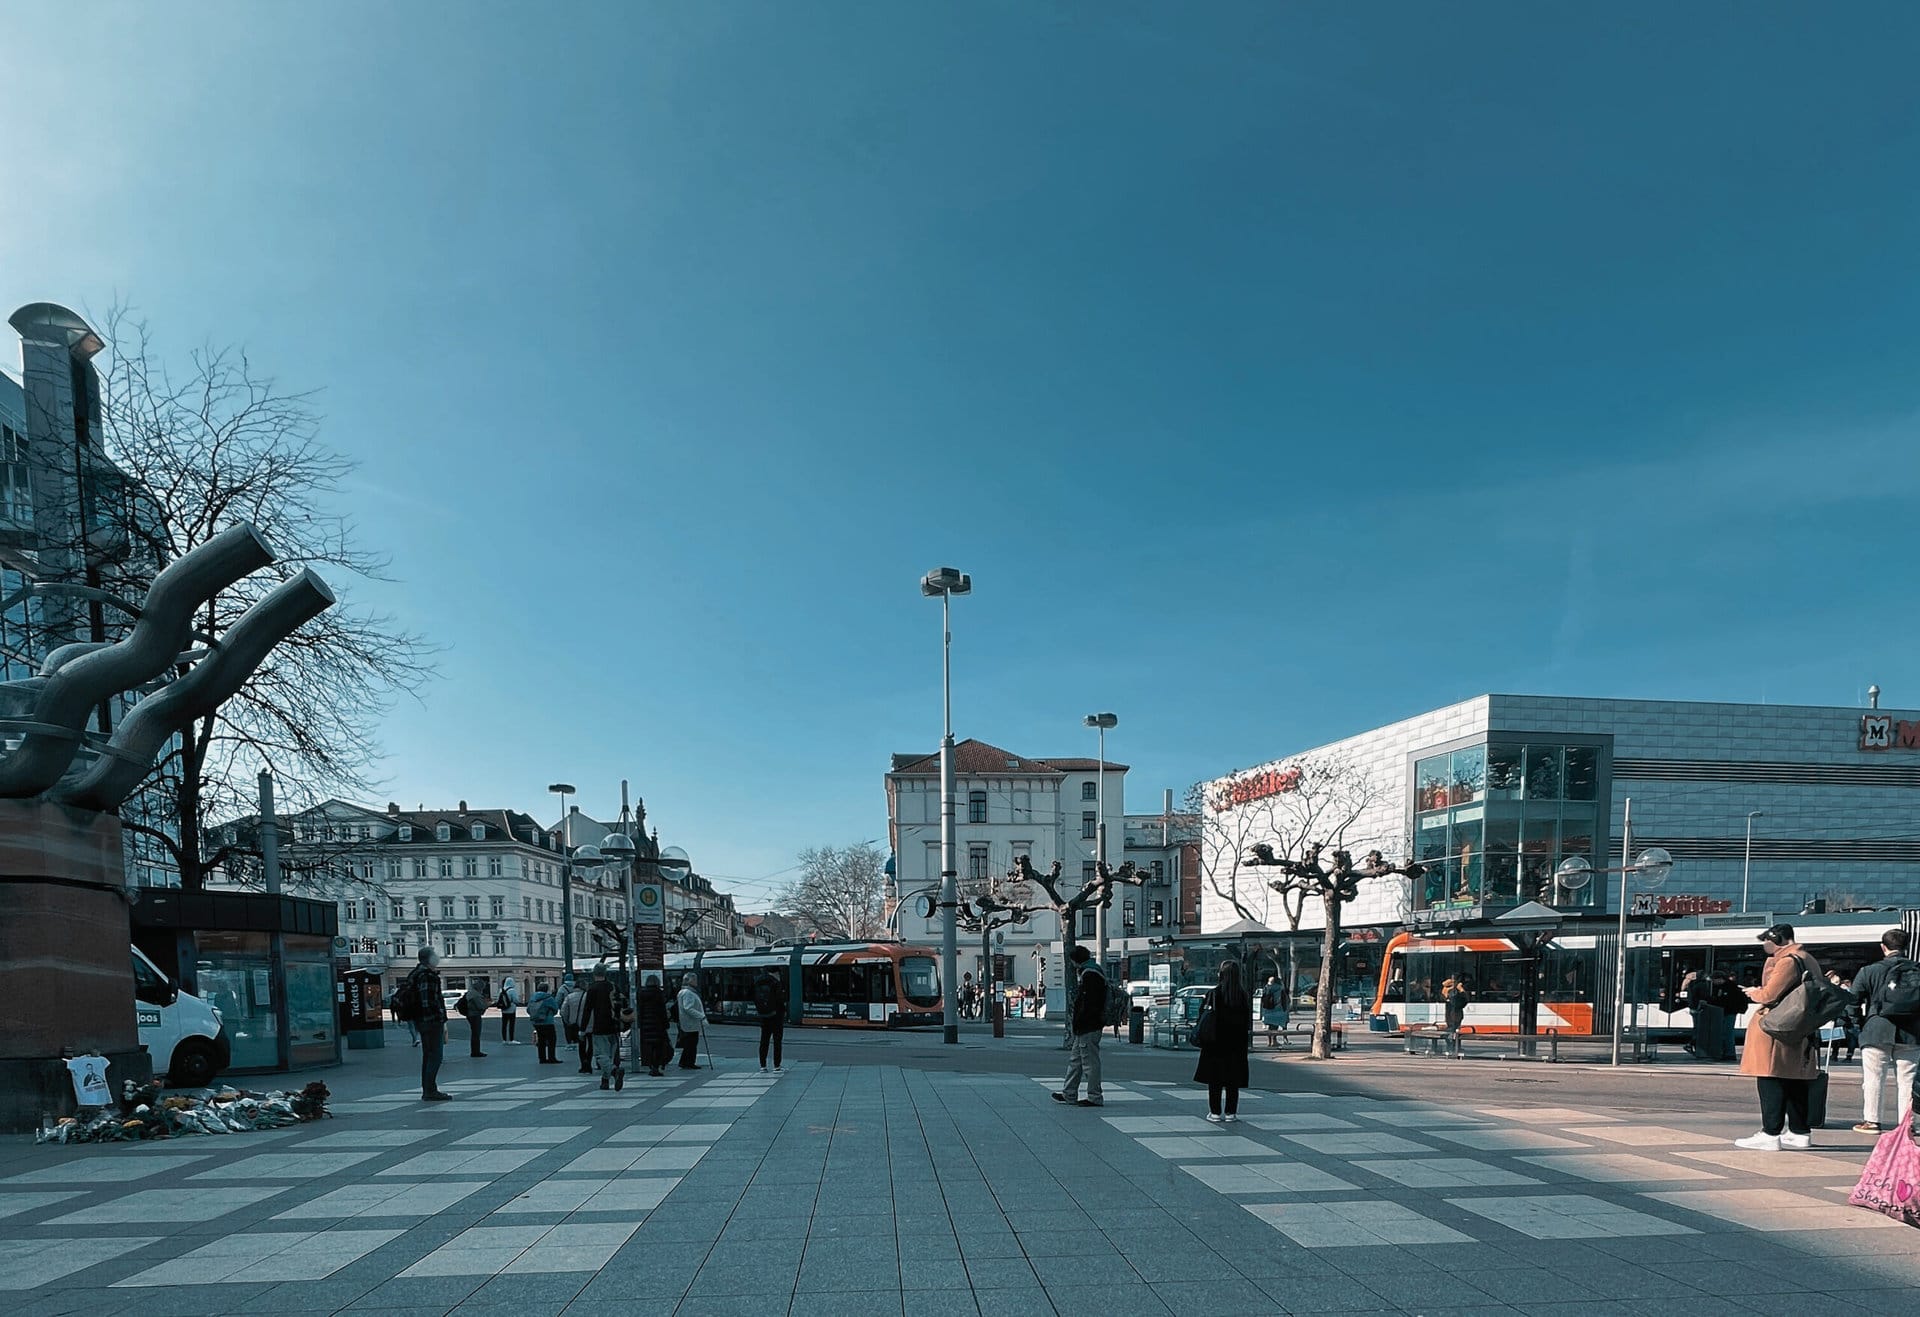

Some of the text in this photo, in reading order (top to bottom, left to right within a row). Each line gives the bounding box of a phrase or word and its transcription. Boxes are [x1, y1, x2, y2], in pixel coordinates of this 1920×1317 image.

[1657, 895, 1731, 914] Müller
[350, 984, 361, 1018] Tickets
[1865, 1172, 1893, 1191] Ich
